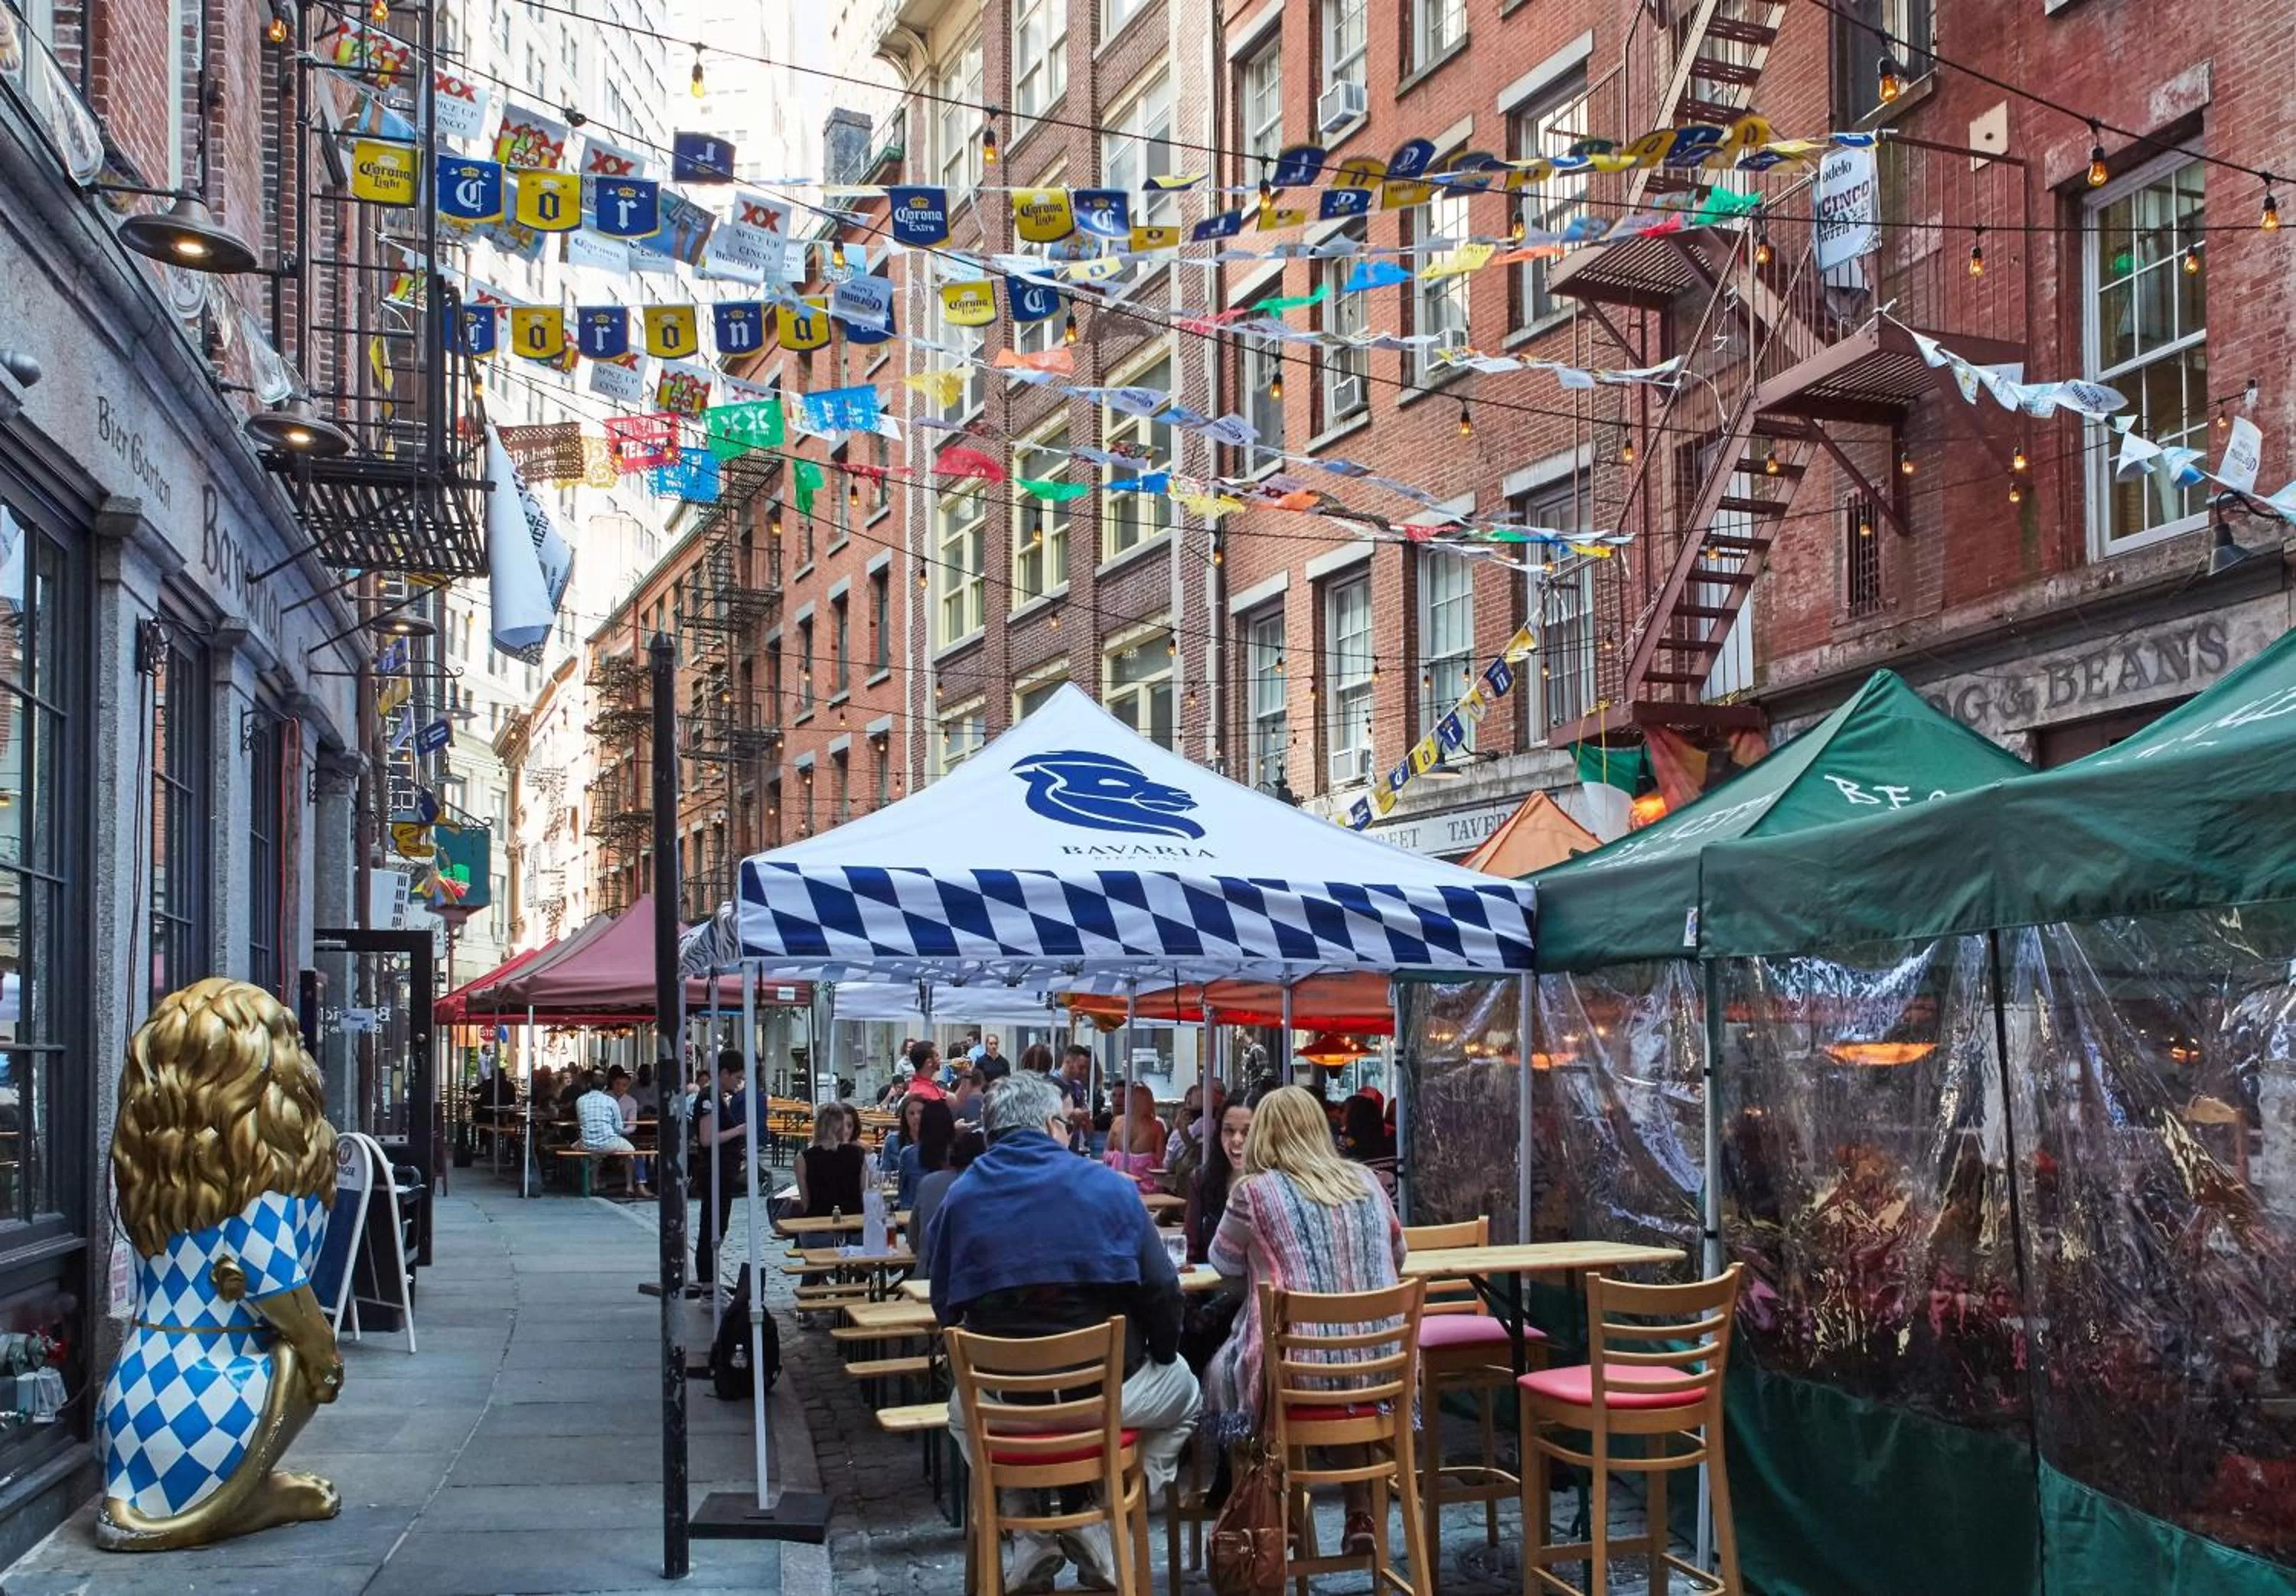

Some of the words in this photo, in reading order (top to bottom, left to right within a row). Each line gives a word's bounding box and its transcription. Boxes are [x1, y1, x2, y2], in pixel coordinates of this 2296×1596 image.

[359, 161, 411, 181] Corona
[1822, 159, 1852, 183] odelo
[1821, 179, 1870, 217] CINCO
[894, 205, 944, 224] Corona
[1019, 202, 1064, 217] Corona
[908, 222, 935, 233] Extra
[948, 297, 989, 310] Corona
[97, 396, 129, 461] Bier
[130, 432, 172, 512] Garten
[2042, 620, 2228, 710] BEANS
[1061, 844, 1218, 860] BAVARIA
[481, 1028, 496, 1037] STO
